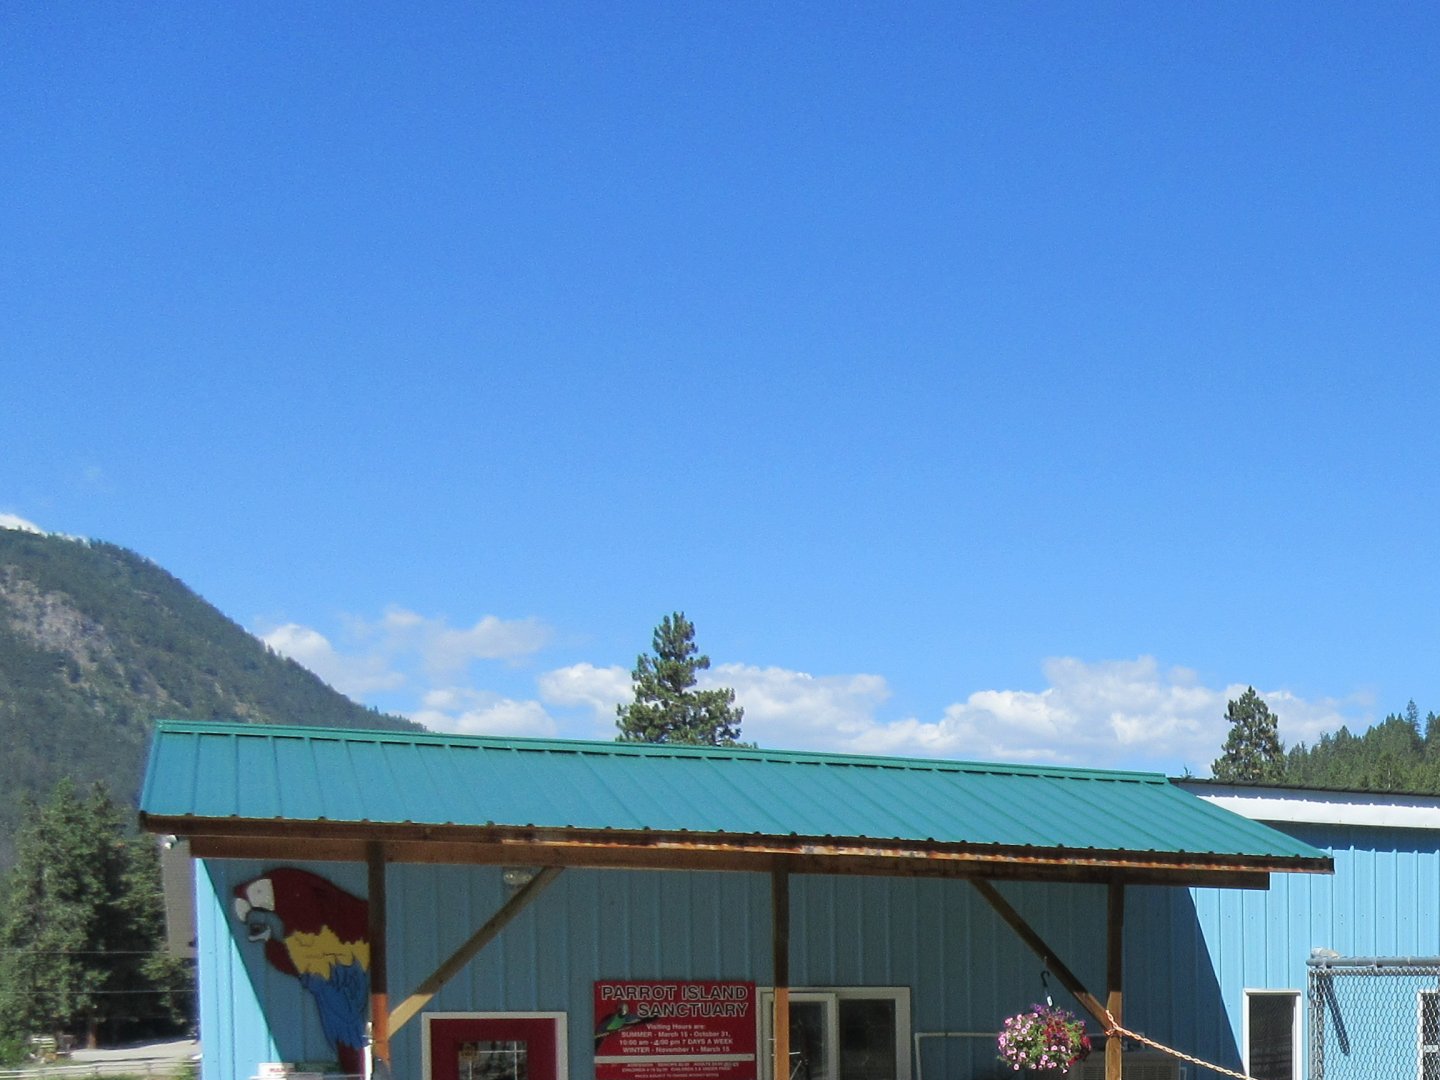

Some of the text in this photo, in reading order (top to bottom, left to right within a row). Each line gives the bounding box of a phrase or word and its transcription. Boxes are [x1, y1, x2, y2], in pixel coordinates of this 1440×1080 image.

[601, 985, 748, 1001] PARROT ISLAND
[637, 1002, 749, 1018] SANCTUARY
